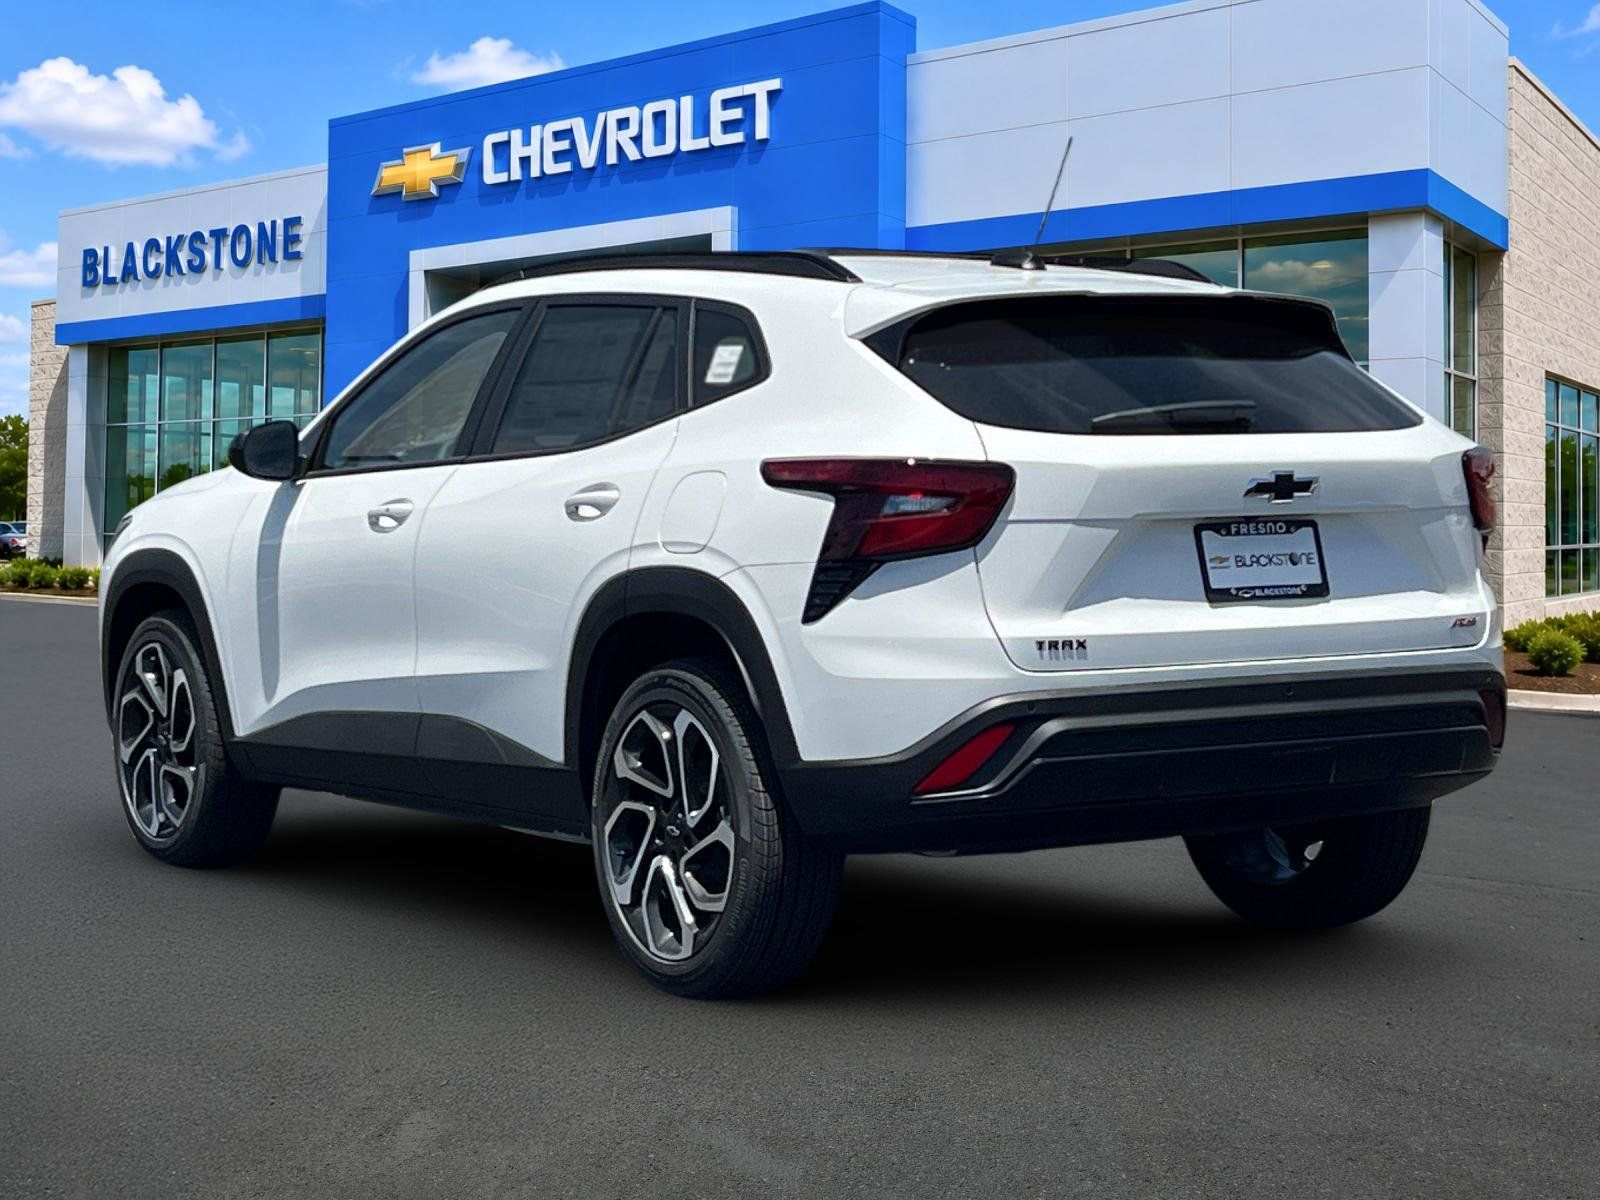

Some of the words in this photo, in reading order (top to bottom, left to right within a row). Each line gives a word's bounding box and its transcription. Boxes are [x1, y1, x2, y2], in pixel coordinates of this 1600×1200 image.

[482, 77, 783, 186] CHEVROLET
[82, 215, 303, 288] BLACKSTONE
[1231, 522, 1287, 535] FRESNO
[1036, 638, 1087, 651] TRAX
